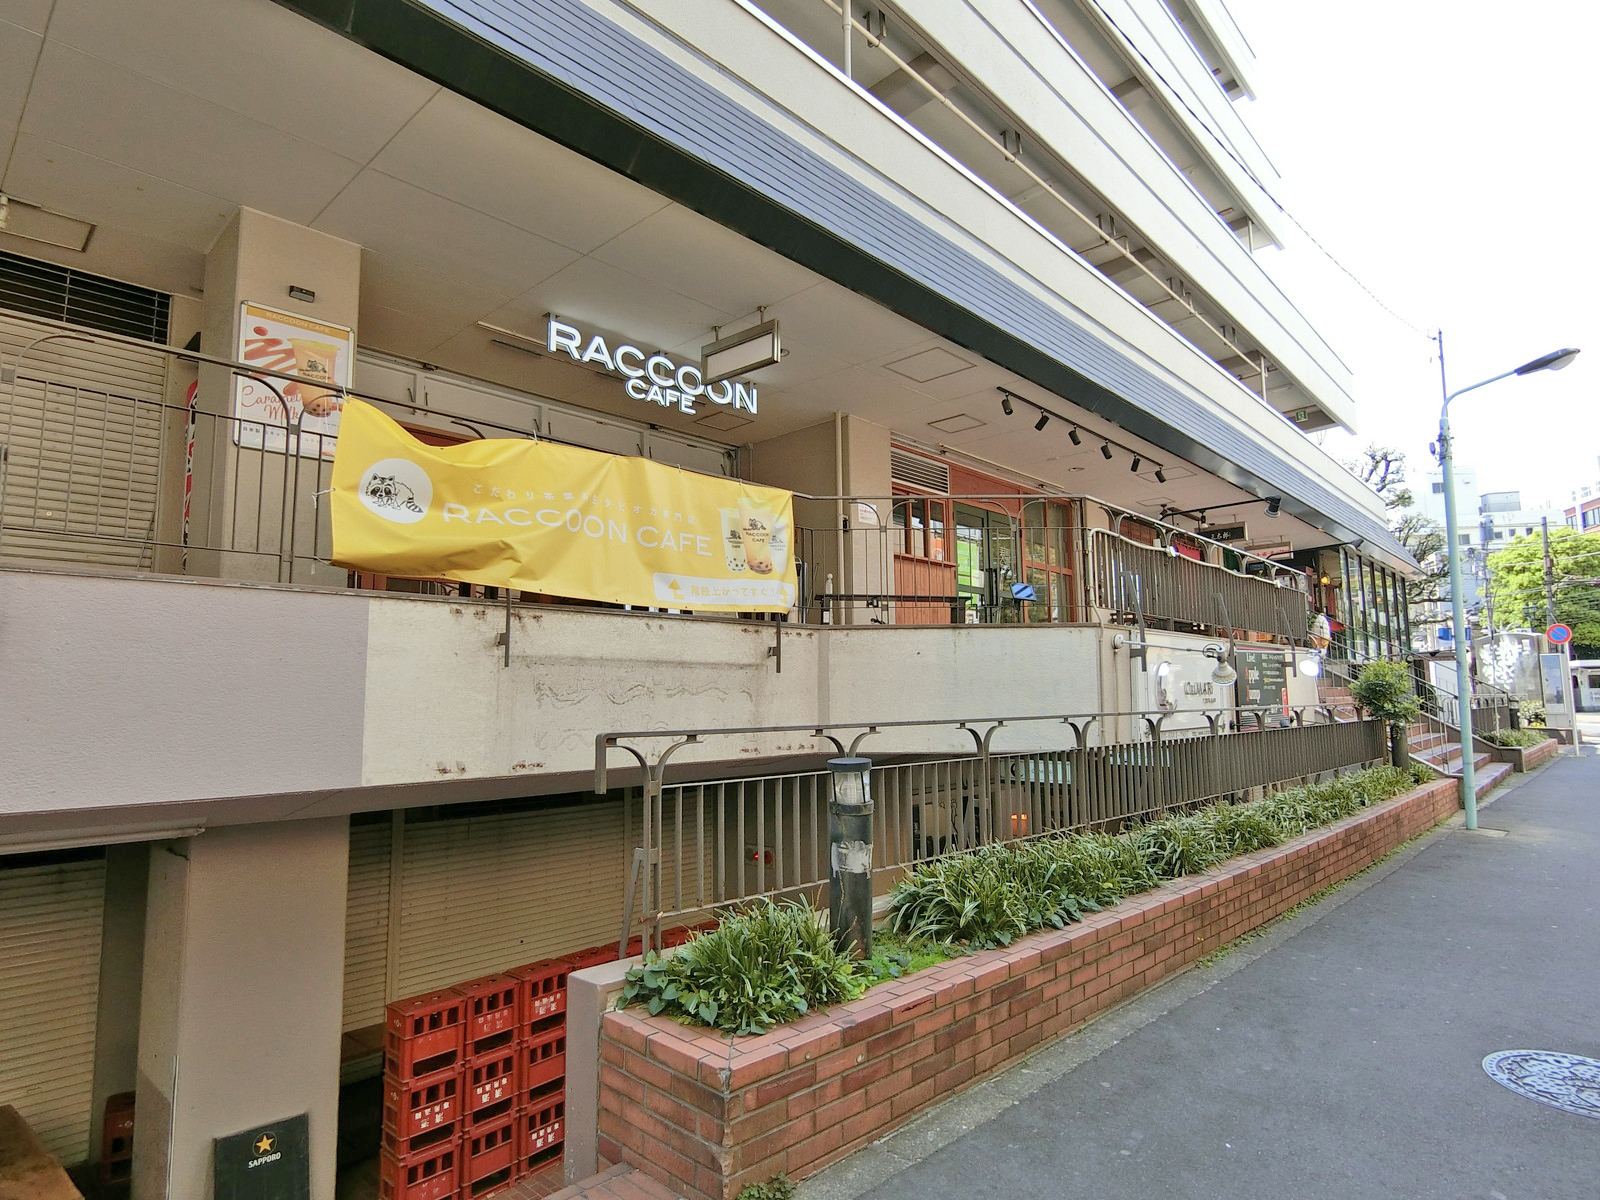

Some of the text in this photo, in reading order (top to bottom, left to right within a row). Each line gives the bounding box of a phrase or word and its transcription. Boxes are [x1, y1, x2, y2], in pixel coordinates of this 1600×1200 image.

[266, 312, 308, 327] RACCOON
[547, 319, 758, 415] RACCOON
[624, 377, 697, 415] CAFE
[441, 501, 714, 557] RACCOON CAFE
[248, 1151, 282, 1169] SAPPORO
